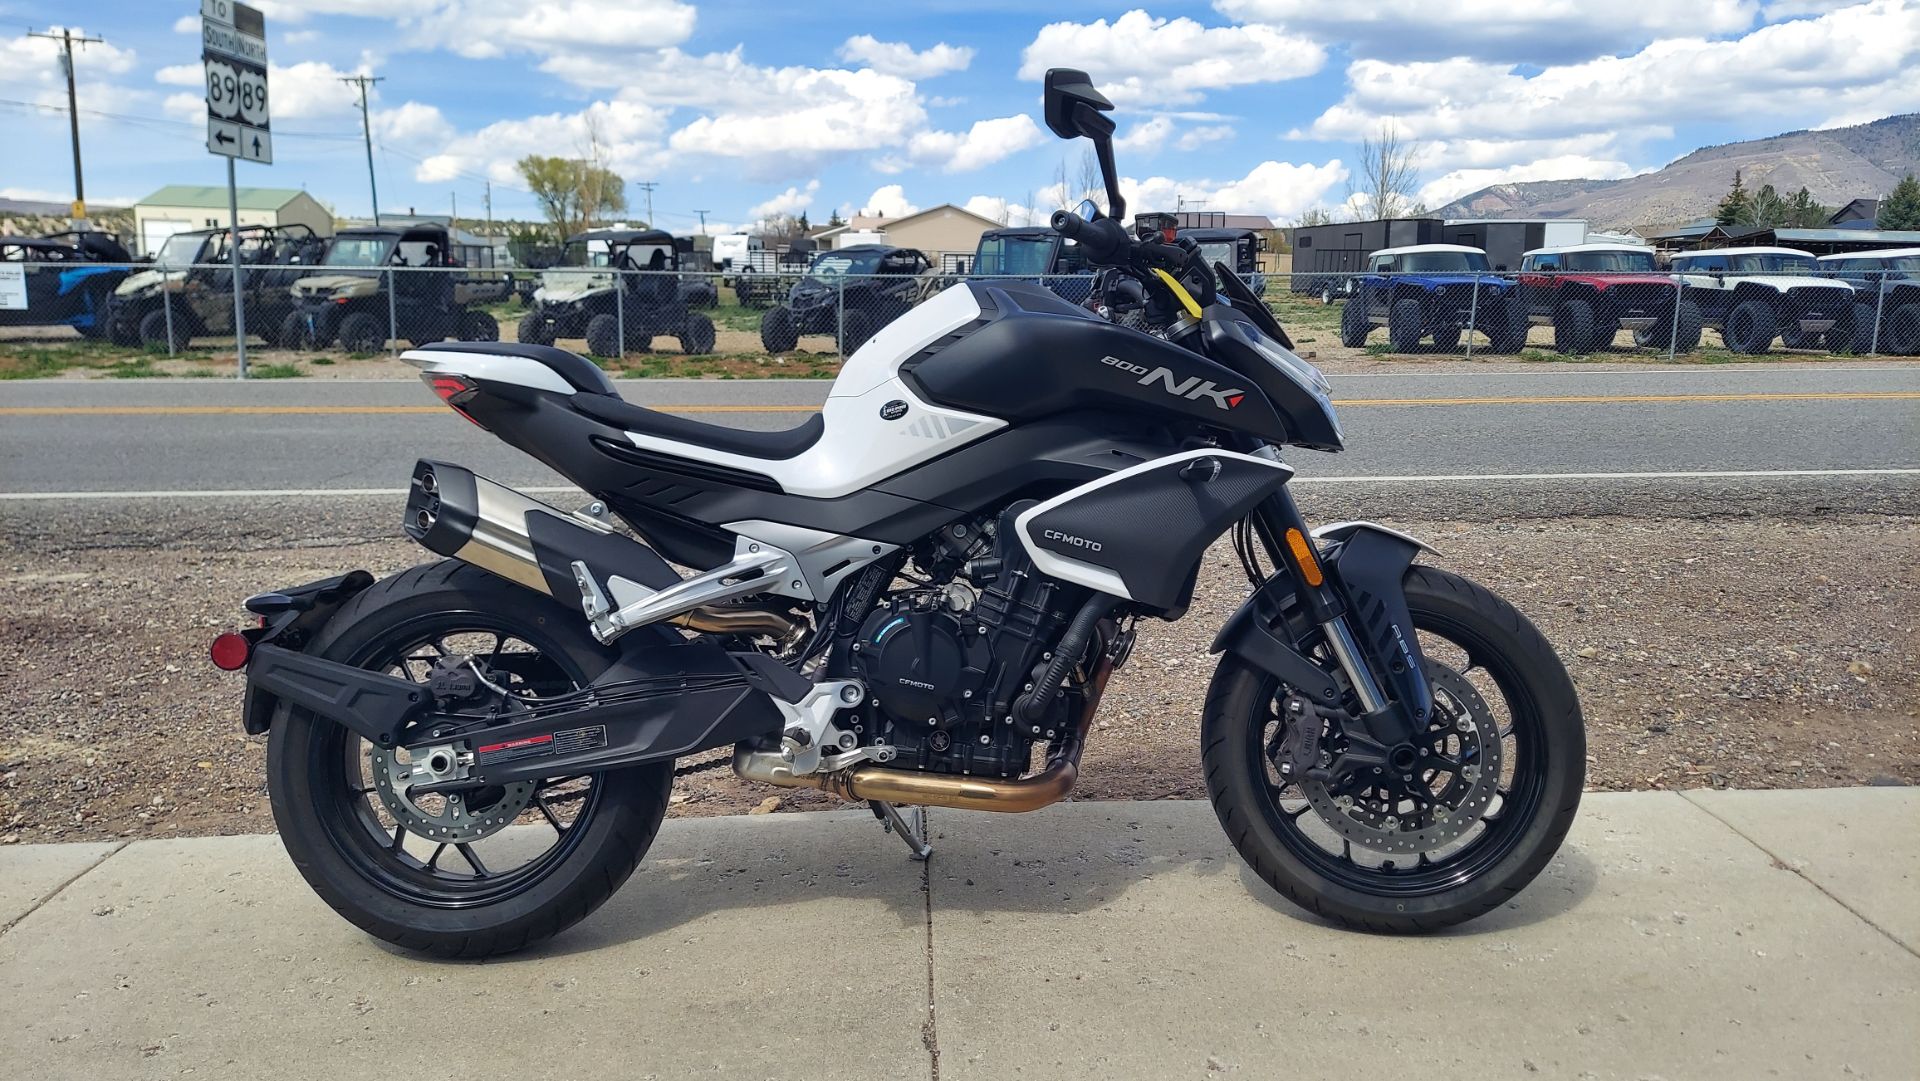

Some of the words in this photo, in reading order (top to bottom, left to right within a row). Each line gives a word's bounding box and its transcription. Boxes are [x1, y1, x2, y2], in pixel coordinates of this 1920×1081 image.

[210, 0, 227, 17] TO
[205, 25, 235, 50] SOUTH
[238, 36, 266, 58] NORTH
[211, 72, 235, 104] 89
[242, 81, 266, 112] 89
[1100, 355, 1149, 376] 800
[1137, 366, 1246, 411] NK
[1044, 529, 1102, 552] CFMOTO
[1392, 624, 1416, 669] ABS
[898, 677, 935, 691] CFMOTO
